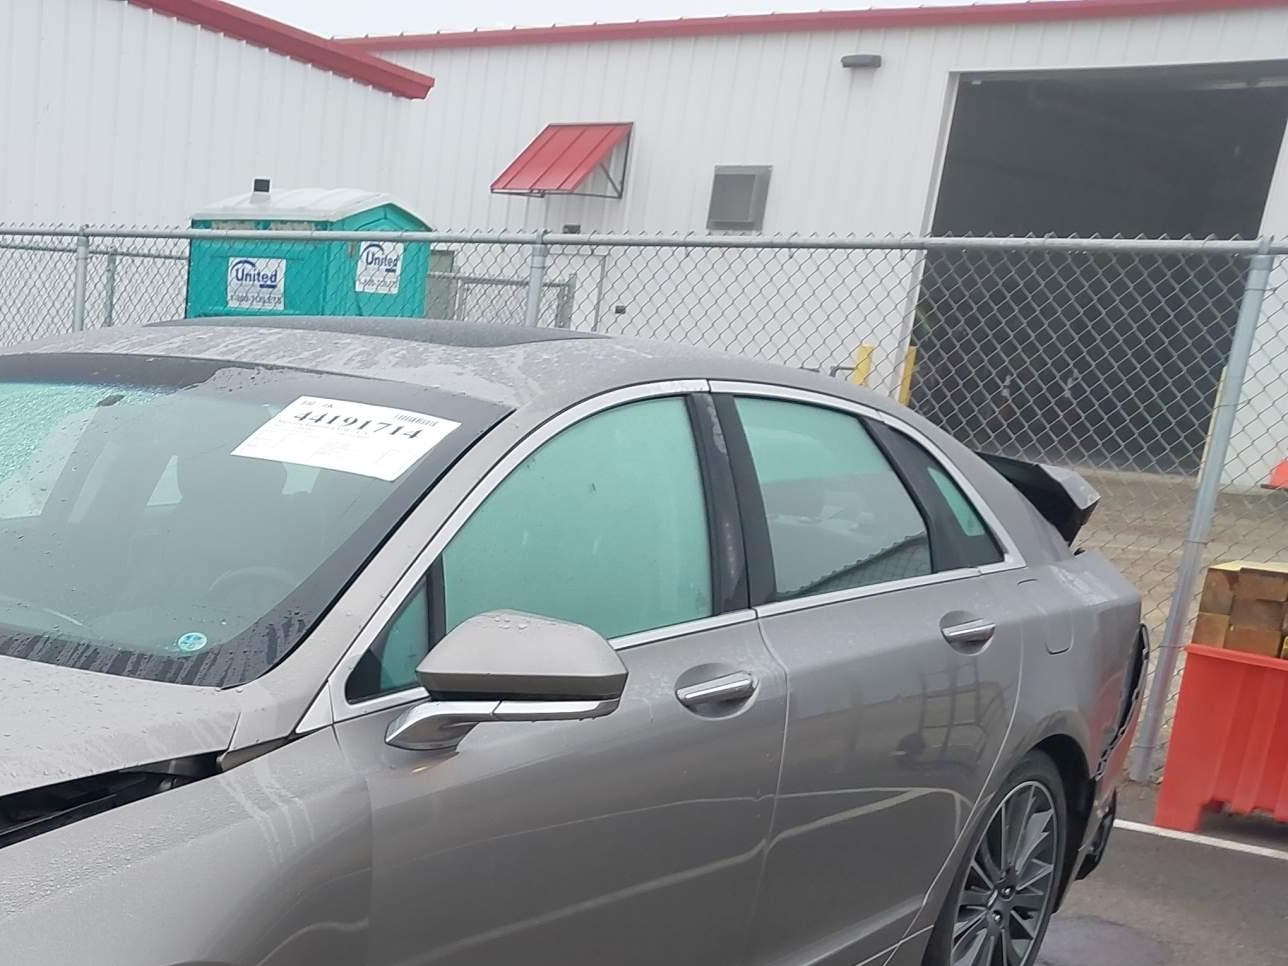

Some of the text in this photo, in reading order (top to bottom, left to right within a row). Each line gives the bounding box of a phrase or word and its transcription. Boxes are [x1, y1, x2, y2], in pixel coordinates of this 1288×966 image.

[366, 250, 399, 266] United
[235, 268, 278, 283] United
[293, 410, 424, 440] 44191714
